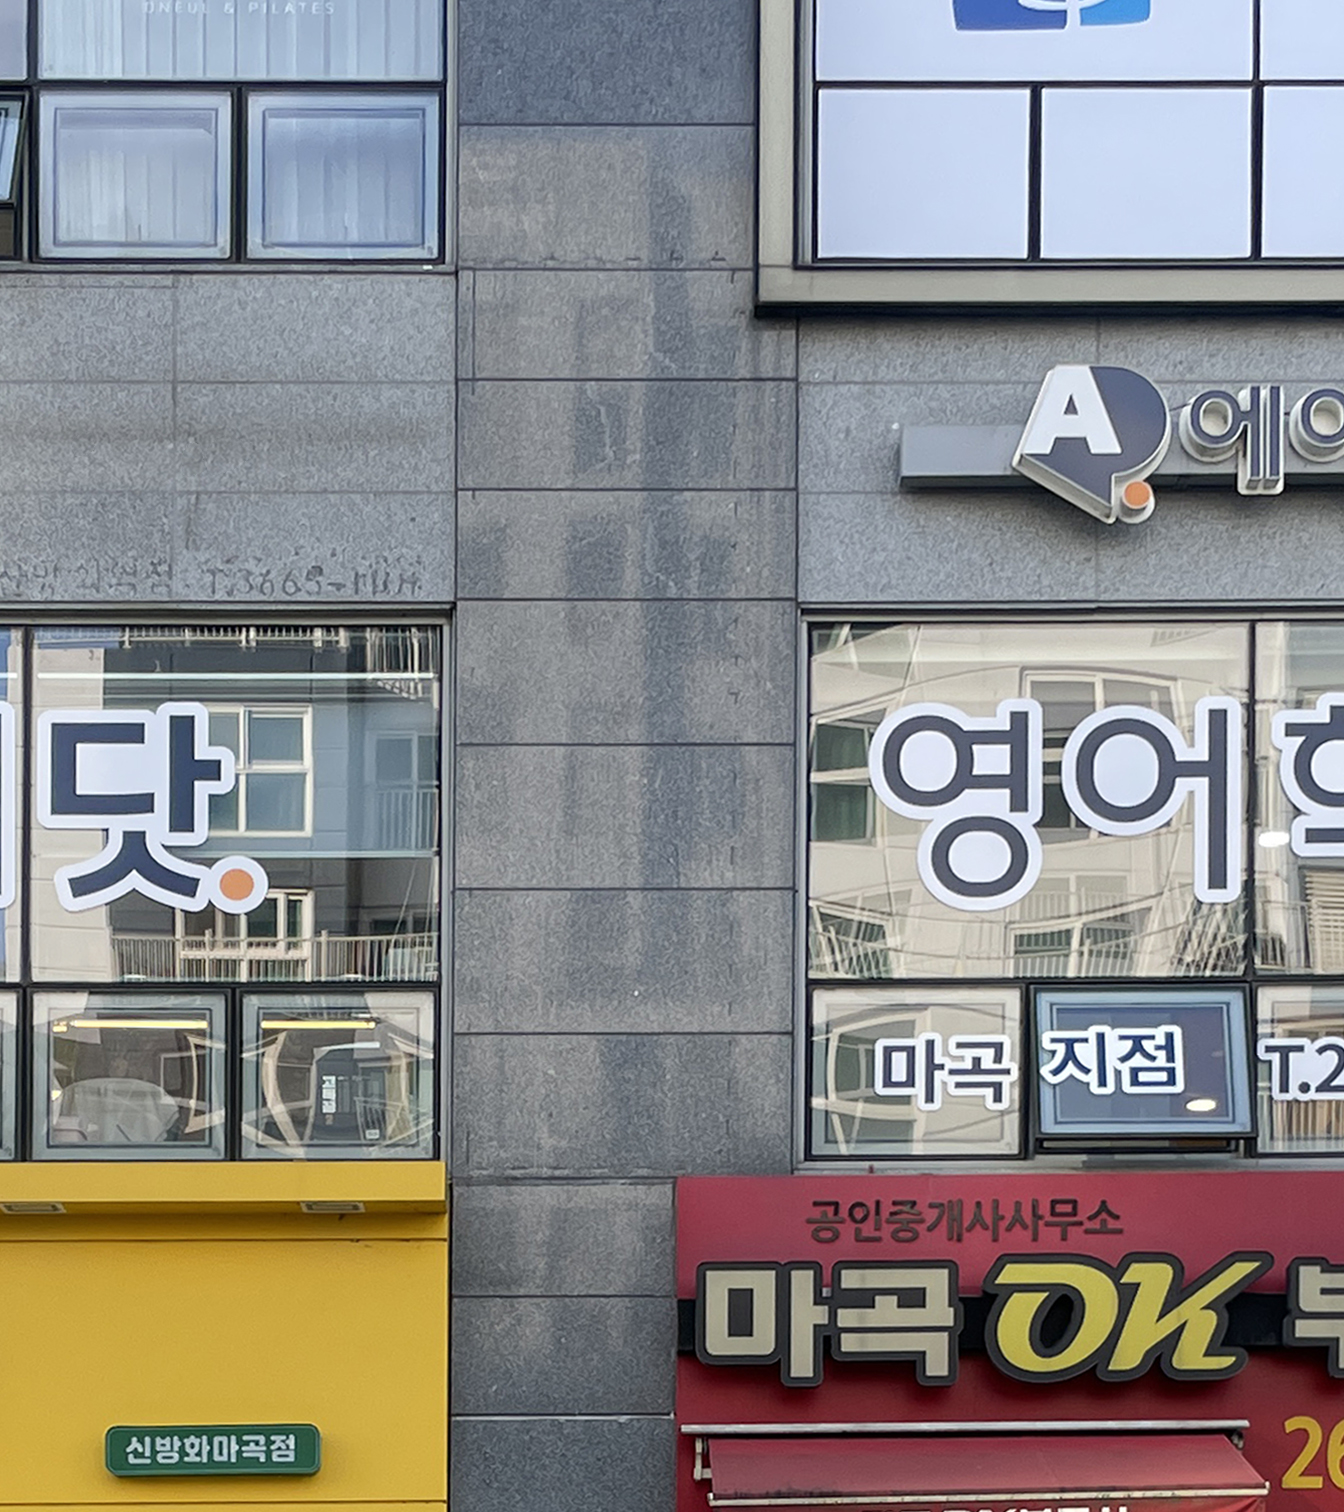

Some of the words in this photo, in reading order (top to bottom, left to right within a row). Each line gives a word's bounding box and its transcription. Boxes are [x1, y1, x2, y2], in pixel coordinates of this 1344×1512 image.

[875, 1035, 1017, 1111] 마곡
[1041, 1025, 1185, 1096] 지점
[805, 1198, 1125, 1243] 공인중개사사무소
[698, 1260, 960, 1386] 마곡
[986, 1252, 1273, 1383] OK
[124, 1434, 298, 1466] 신방화마곡점
